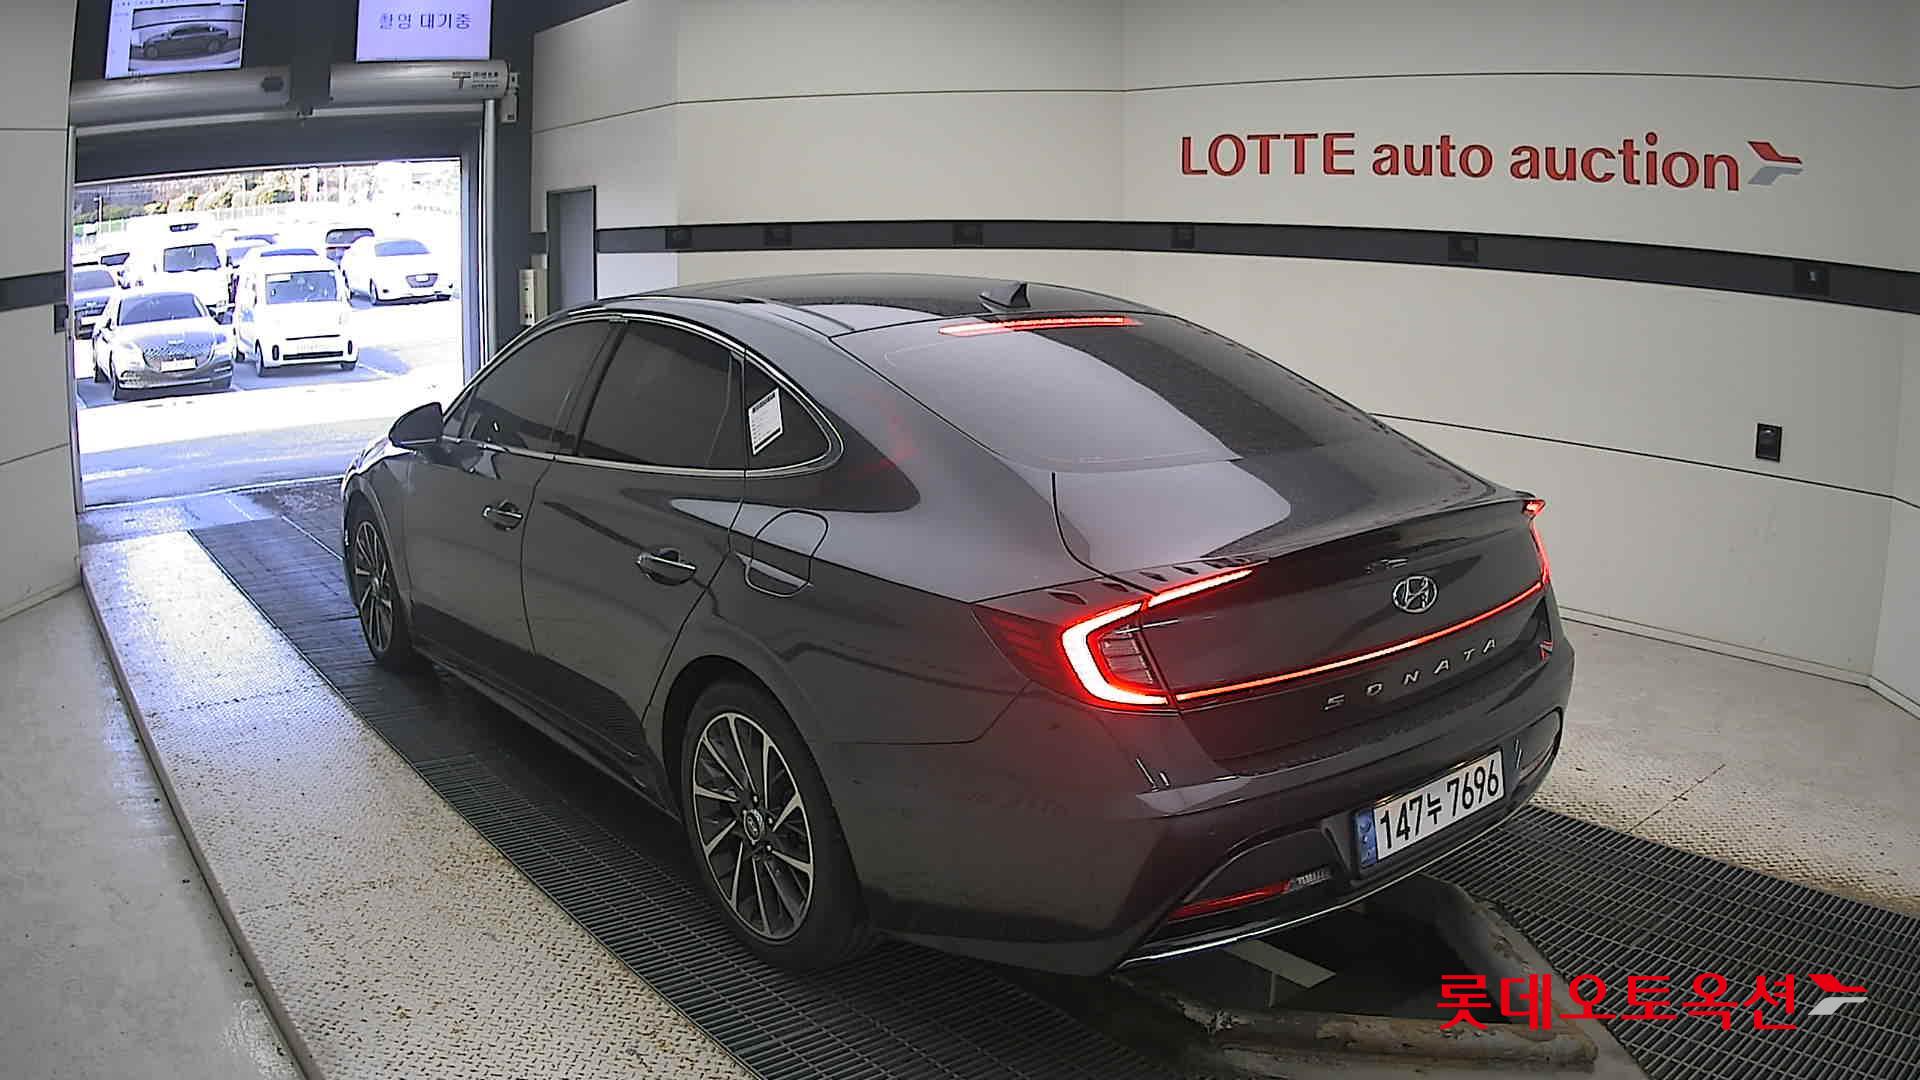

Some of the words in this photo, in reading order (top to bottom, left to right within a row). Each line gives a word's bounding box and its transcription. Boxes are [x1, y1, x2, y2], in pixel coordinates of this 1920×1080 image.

[420, 13, 472, 30] 대기중
[1181, 132, 1355, 176] LOTTE
[1372, 135, 1493, 178] auto
[1509, 132, 1739, 191] auction
[1323, 638, 1496, 711] SONATA
[1380, 792, 1442, 849] 147누
[1447, 759, 1499, 817] 7696
